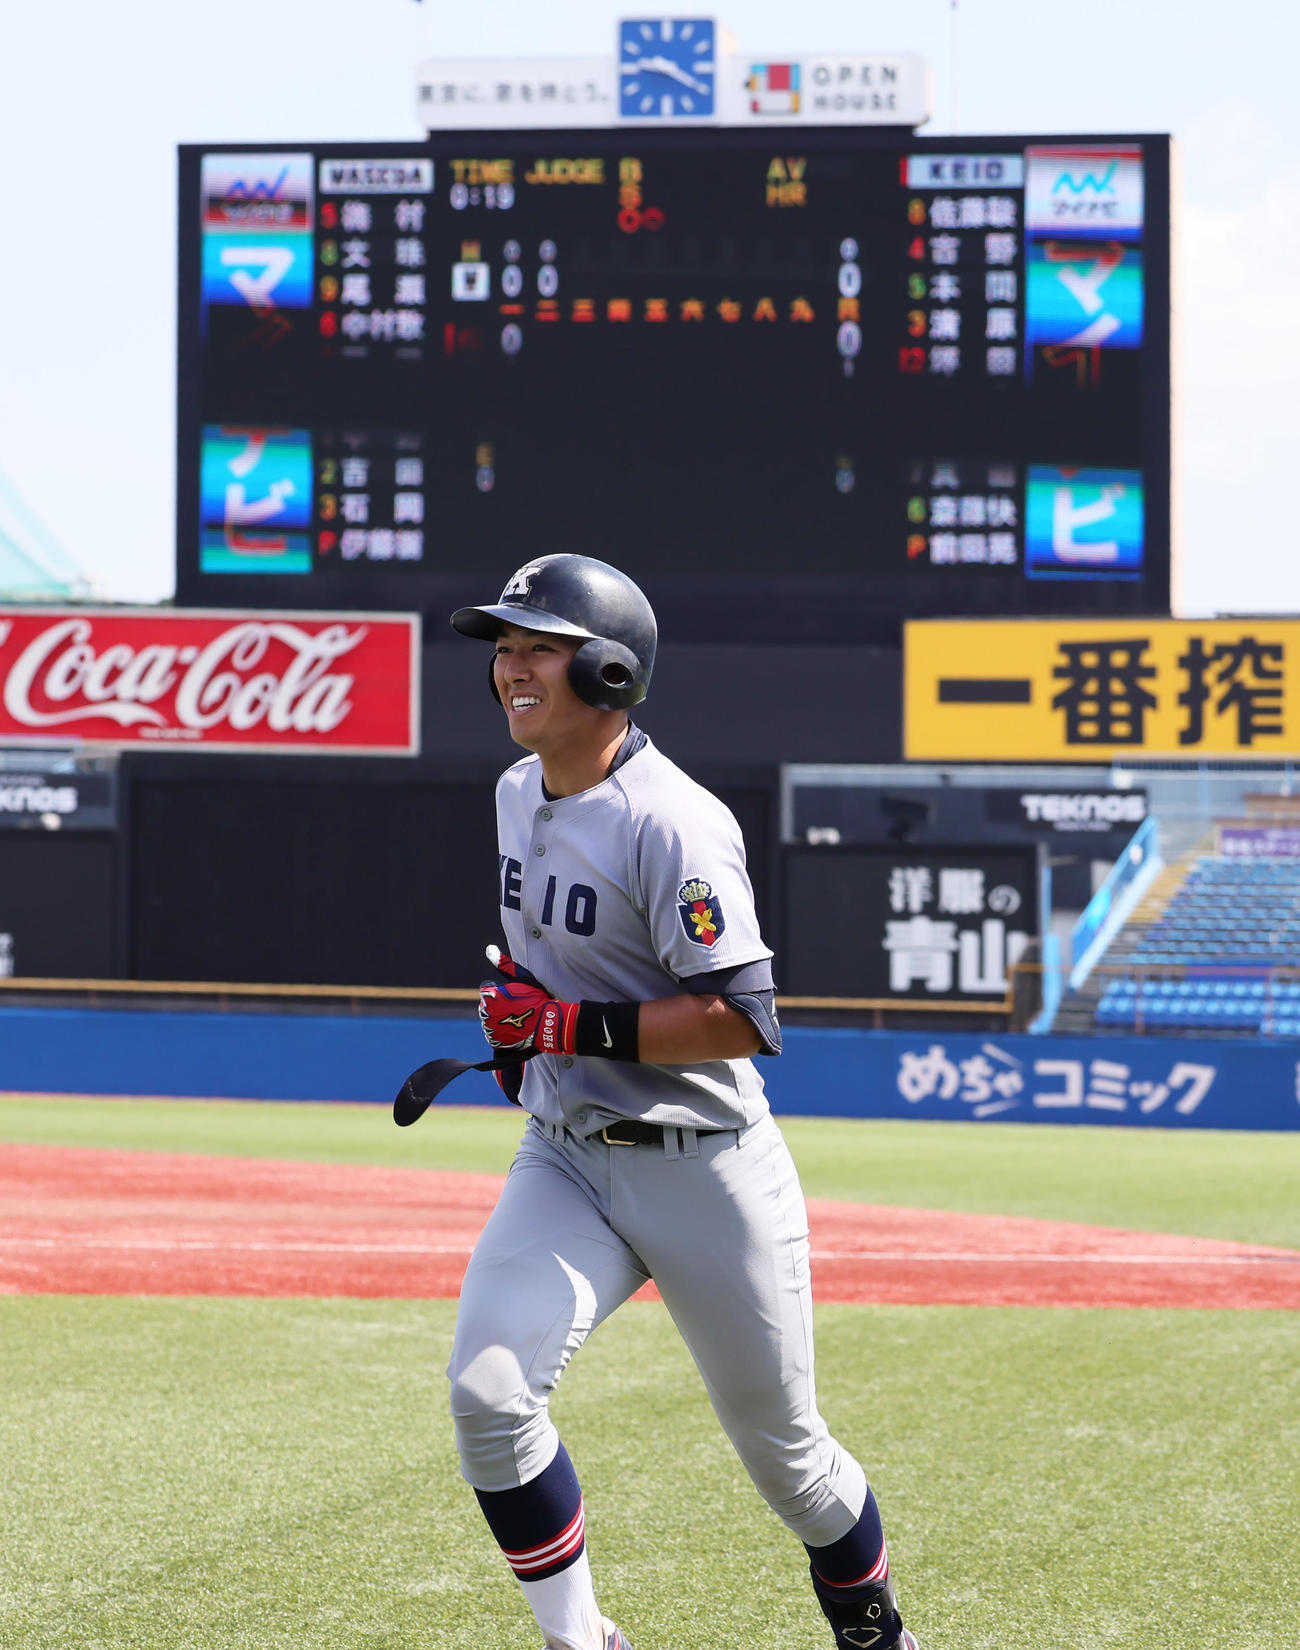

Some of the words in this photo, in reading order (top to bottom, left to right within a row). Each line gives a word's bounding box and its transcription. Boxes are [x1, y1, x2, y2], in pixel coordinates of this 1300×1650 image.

[812, 66, 898, 85] OPEN
[813, 93, 898, 111] HOUSE
[450, 158, 514, 185] TIME
[525, 158, 606, 185] JUDGE
[929, 161, 1004, 180] KEIO
[501, 263, 523, 298] 0
[537, 263, 559, 298] 0
[838, 262, 862, 298] 0
[535, 299, 561, 322] 二
[571, 298, 596, 322] 三
[753, 297, 778, 322] 八
[837, 320, 862, 357] 0
[4, 617, 369, 733] Coca-Cola
[937, 636, 1286, 747] 一番搾
[888, 866, 1021, 915] 洋服の
[882, 917, 1028, 993] 青山
[543, 1011, 556, 1048] SHOGO
[897, 1045, 1217, 1116] めちゃコミック
